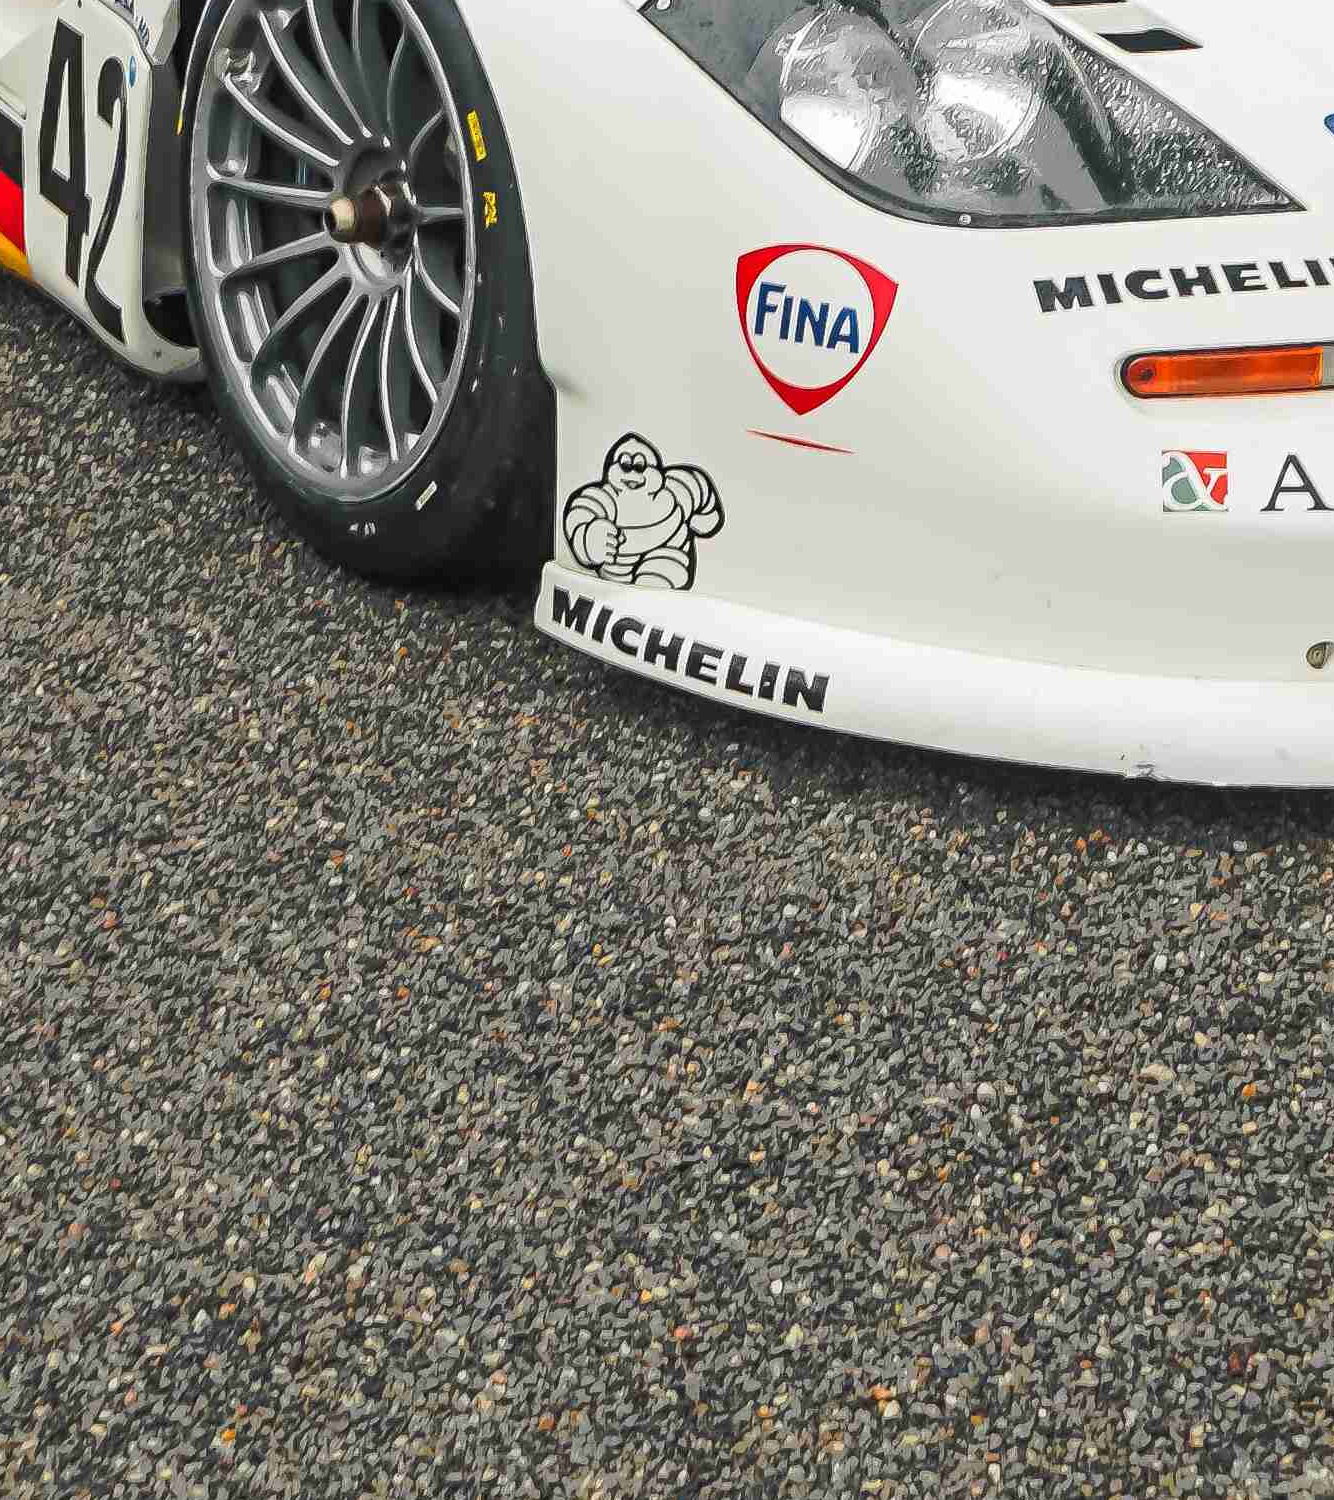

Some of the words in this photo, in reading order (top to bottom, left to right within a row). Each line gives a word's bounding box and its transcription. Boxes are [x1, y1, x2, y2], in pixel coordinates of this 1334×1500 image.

[38, 16, 127, 340] 42
[754, 281, 862, 354] FINA
[551, 586, 831, 714] MICHELIN
